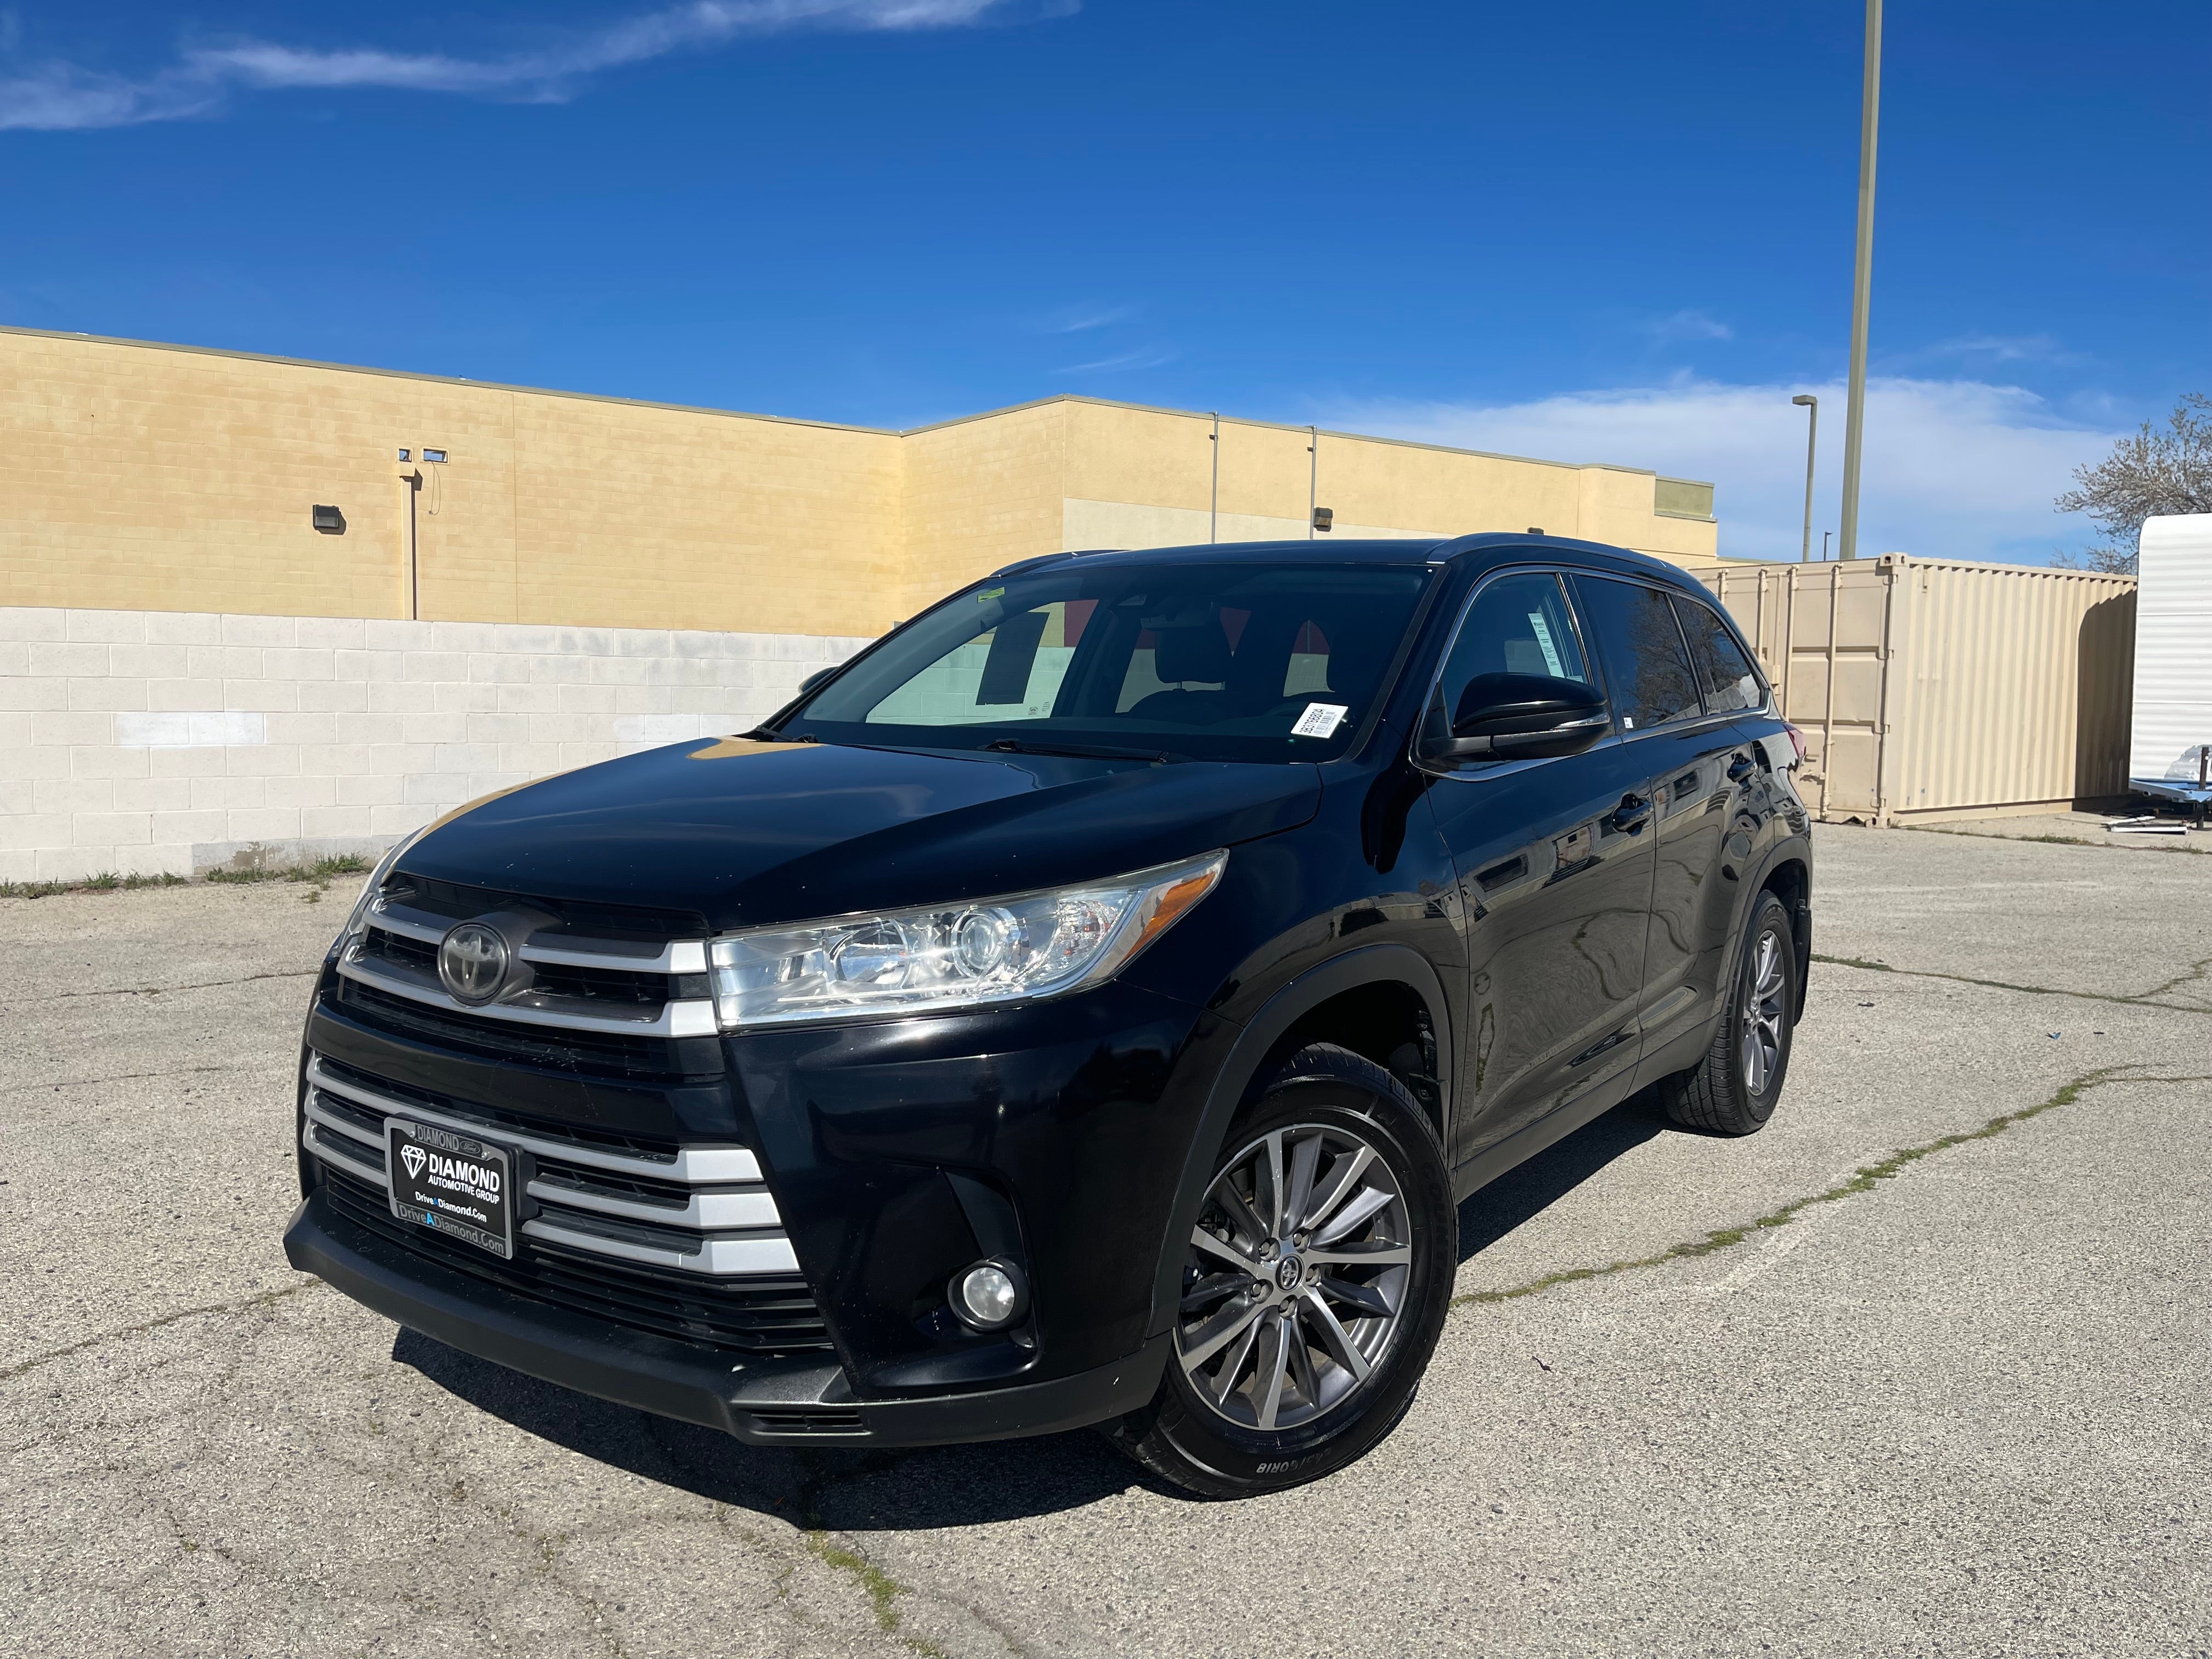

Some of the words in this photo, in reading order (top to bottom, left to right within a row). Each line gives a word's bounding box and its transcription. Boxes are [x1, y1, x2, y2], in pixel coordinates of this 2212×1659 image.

[417, 1126, 460, 1151] DIAMOND
[428, 1174, 475, 1196] AUTOMOTIVE
[476, 1188, 500, 1204] GROUP
[429, 1153, 500, 1192] DIAMOND
[399, 1204, 504, 1255] DriveADiamond.Com
